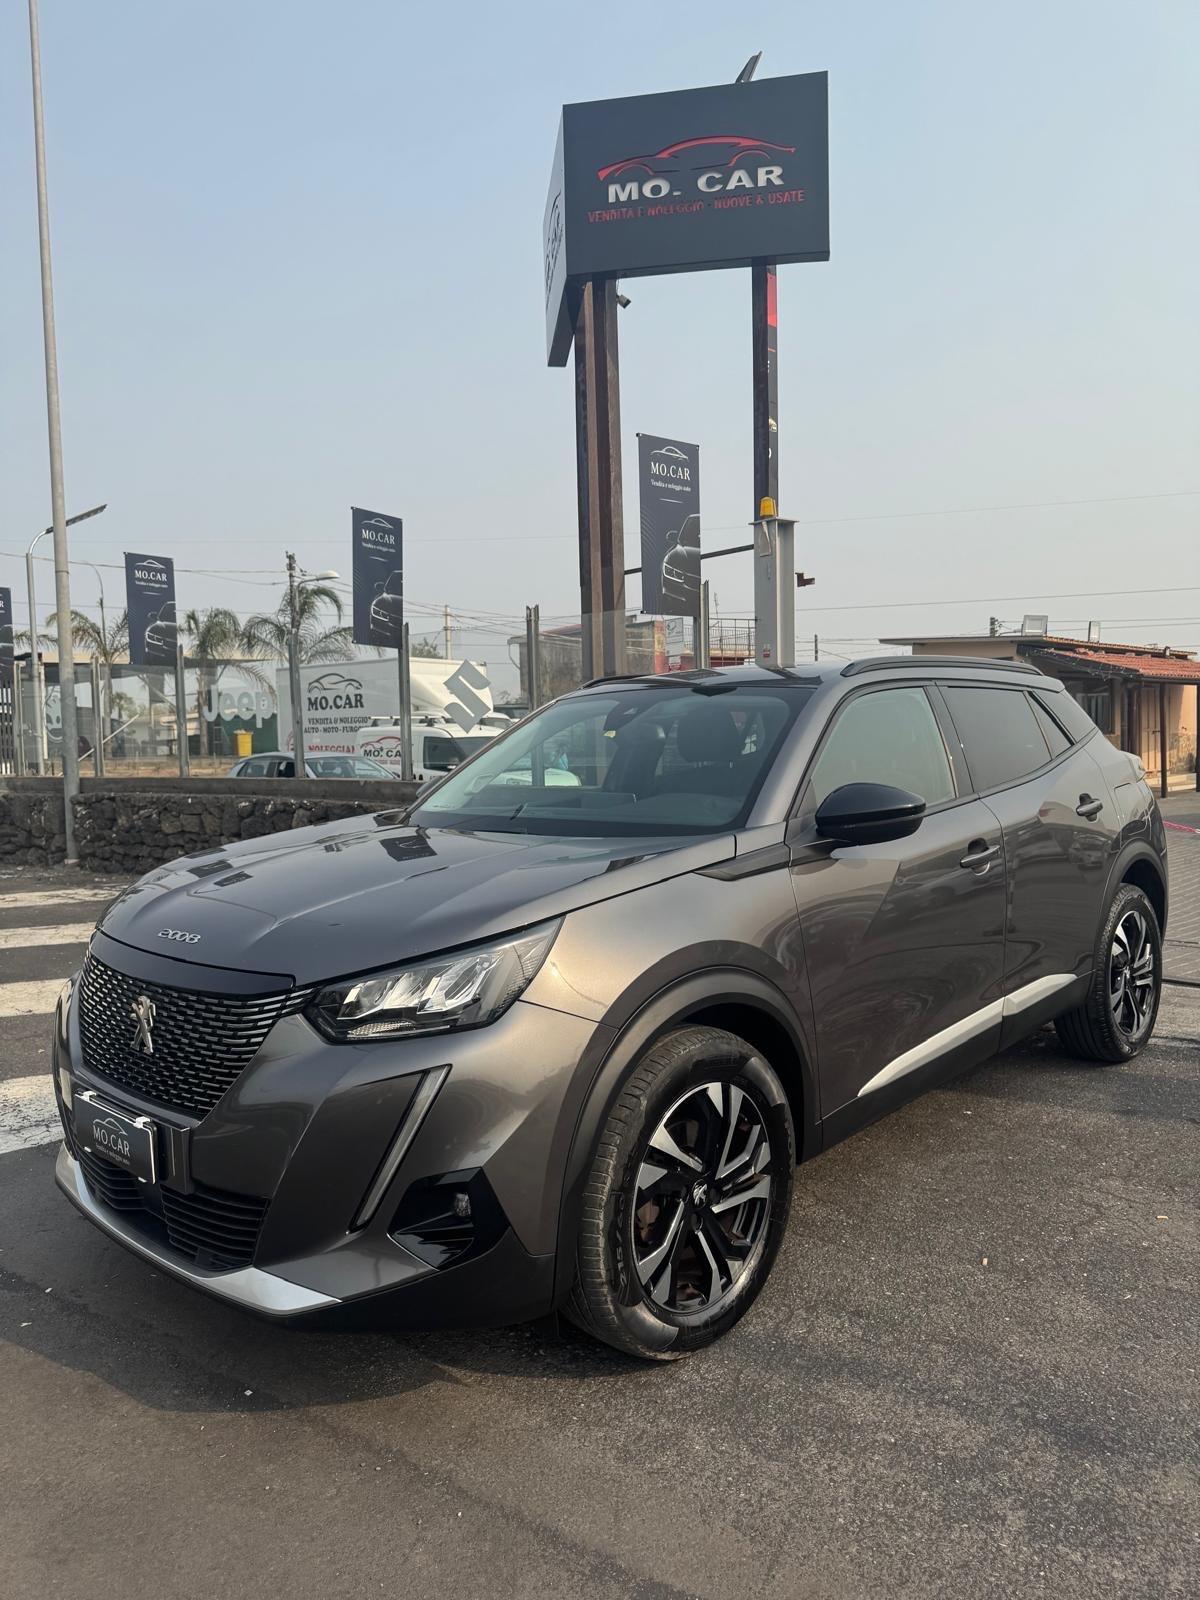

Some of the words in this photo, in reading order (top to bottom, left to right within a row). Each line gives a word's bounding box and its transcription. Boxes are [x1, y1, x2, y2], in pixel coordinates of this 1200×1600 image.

[608, 179, 682, 203] MO.
[697, 165, 785, 192] CAR
[714, 194, 753, 209] NUOVE
[768, 189, 805, 204] USATE
[651, 461, 690, 480] MO.CAR
[361, 529, 395, 544] MO.CAR
[135, 569, 167, 581] MO.CAR
[202, 684, 274, 729] Jeep
[307, 693, 364, 711] MO.CAR
[308, 717, 333, 725] VENDITA
[339, 716, 369, 724] NOLEGGIO
[323, 726, 339, 734] MOTO
[157, 928, 201, 943] 2008
[93, 1125, 131, 1157] MO.CAR
